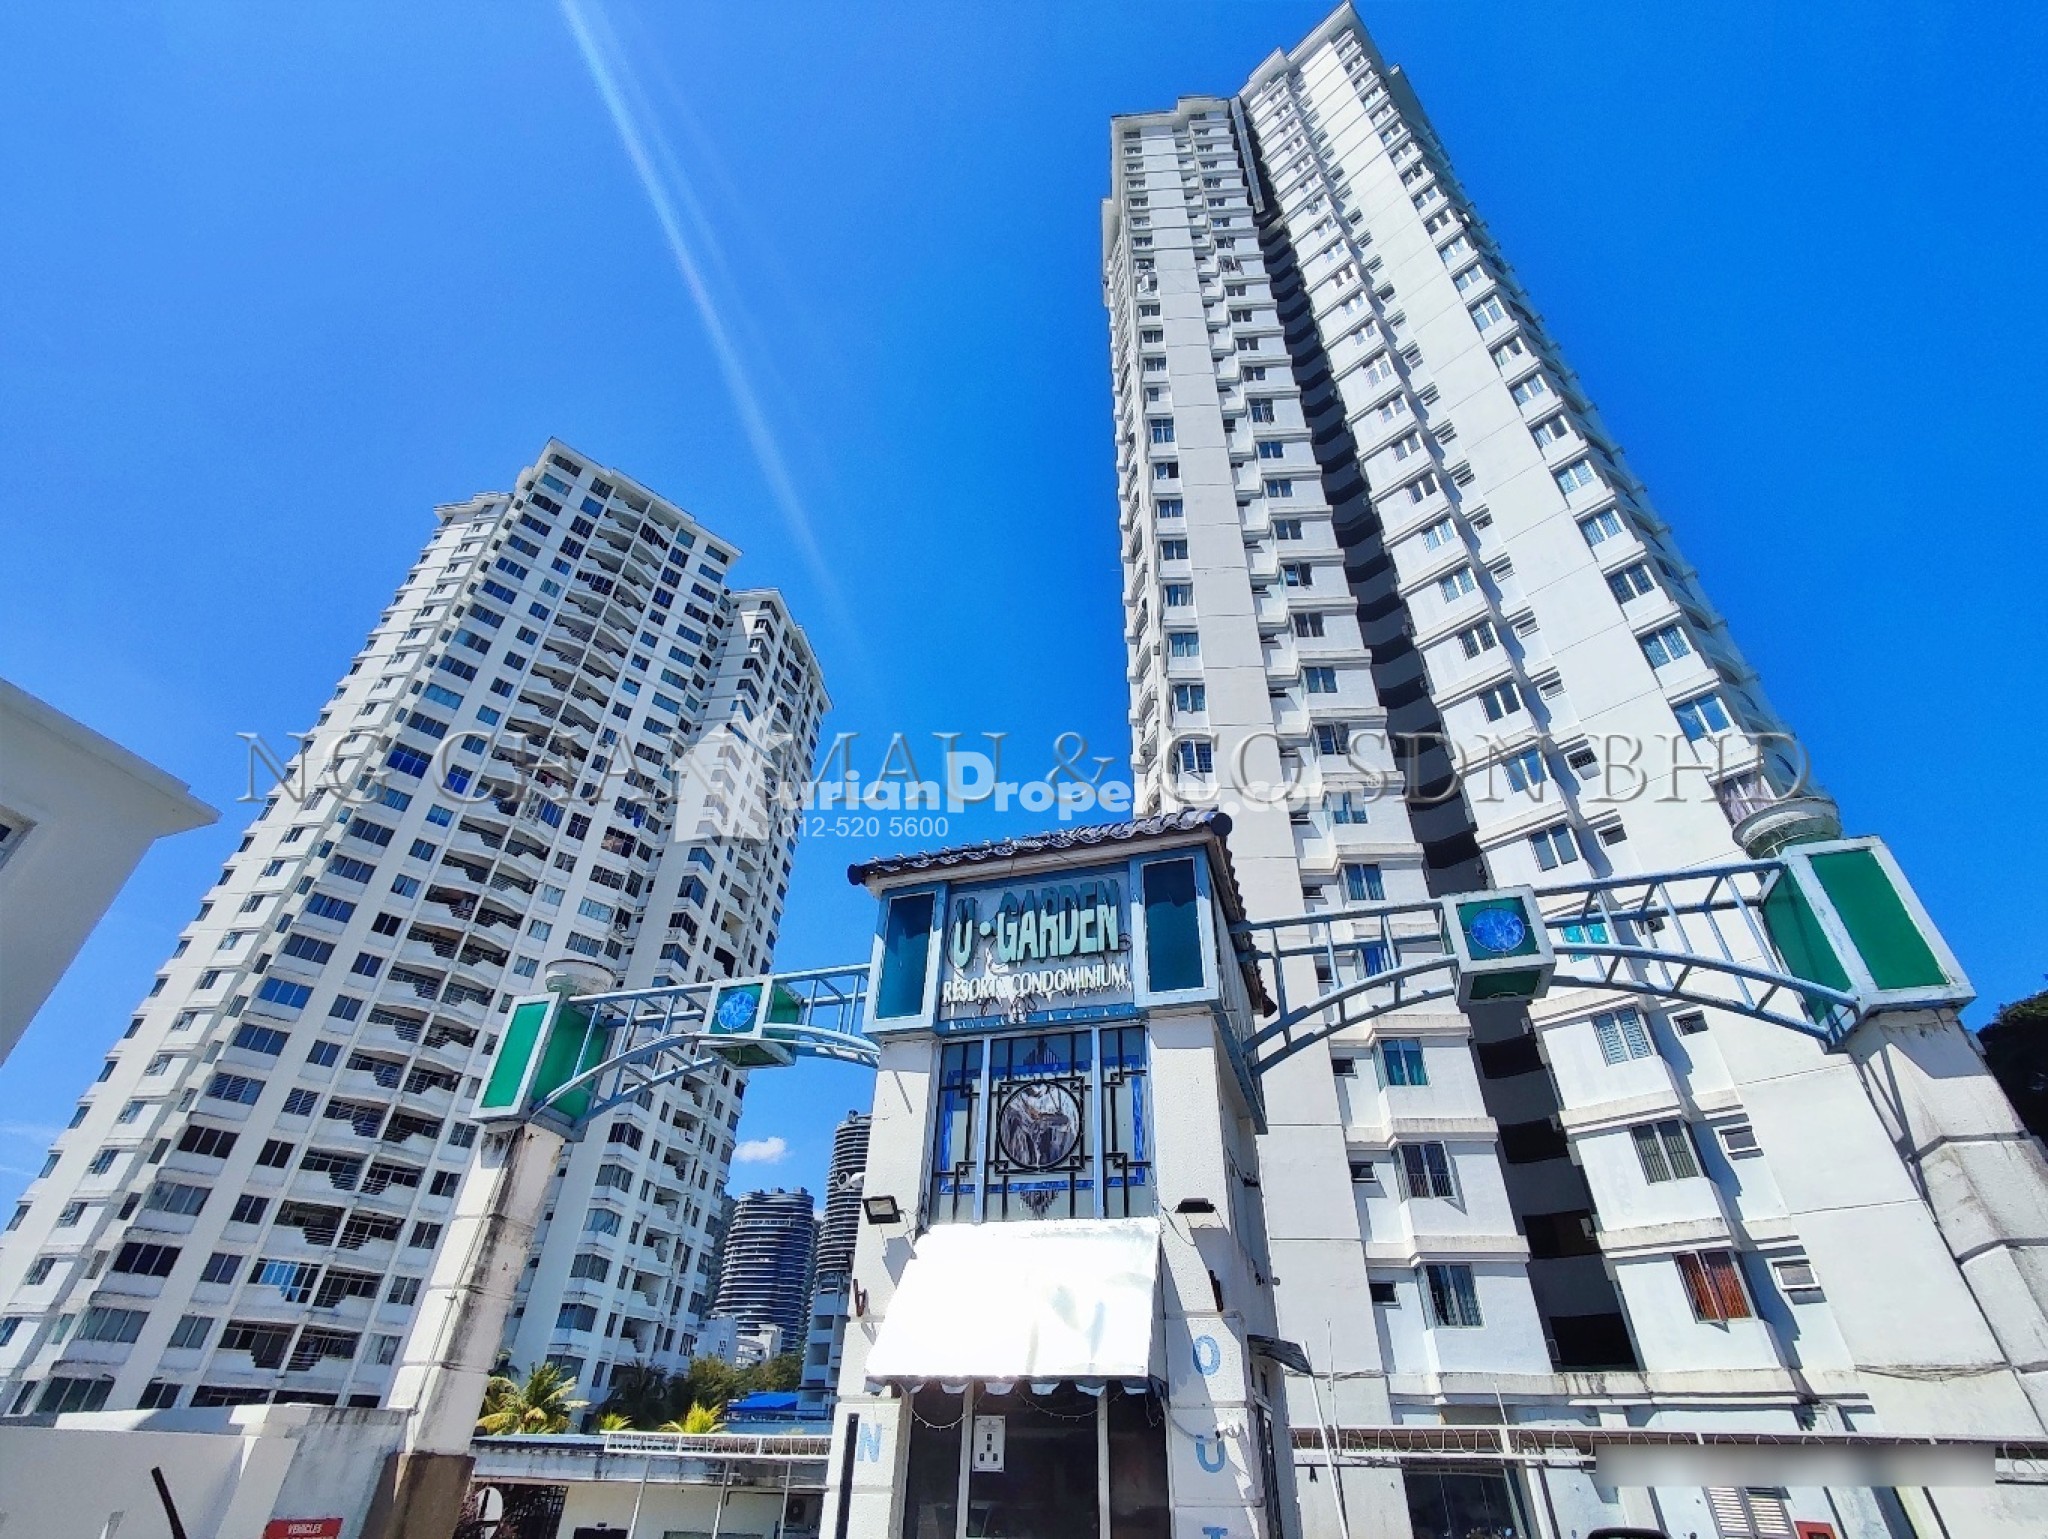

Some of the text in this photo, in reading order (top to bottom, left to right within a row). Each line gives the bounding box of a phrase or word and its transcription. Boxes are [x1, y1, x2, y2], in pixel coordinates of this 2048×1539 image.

[996, 878, 1120, 963] GARDEN
[1012, 962, 1127, 1000] CONDOMINIUM
[287, 1523, 323, 1534] VEHICLES
